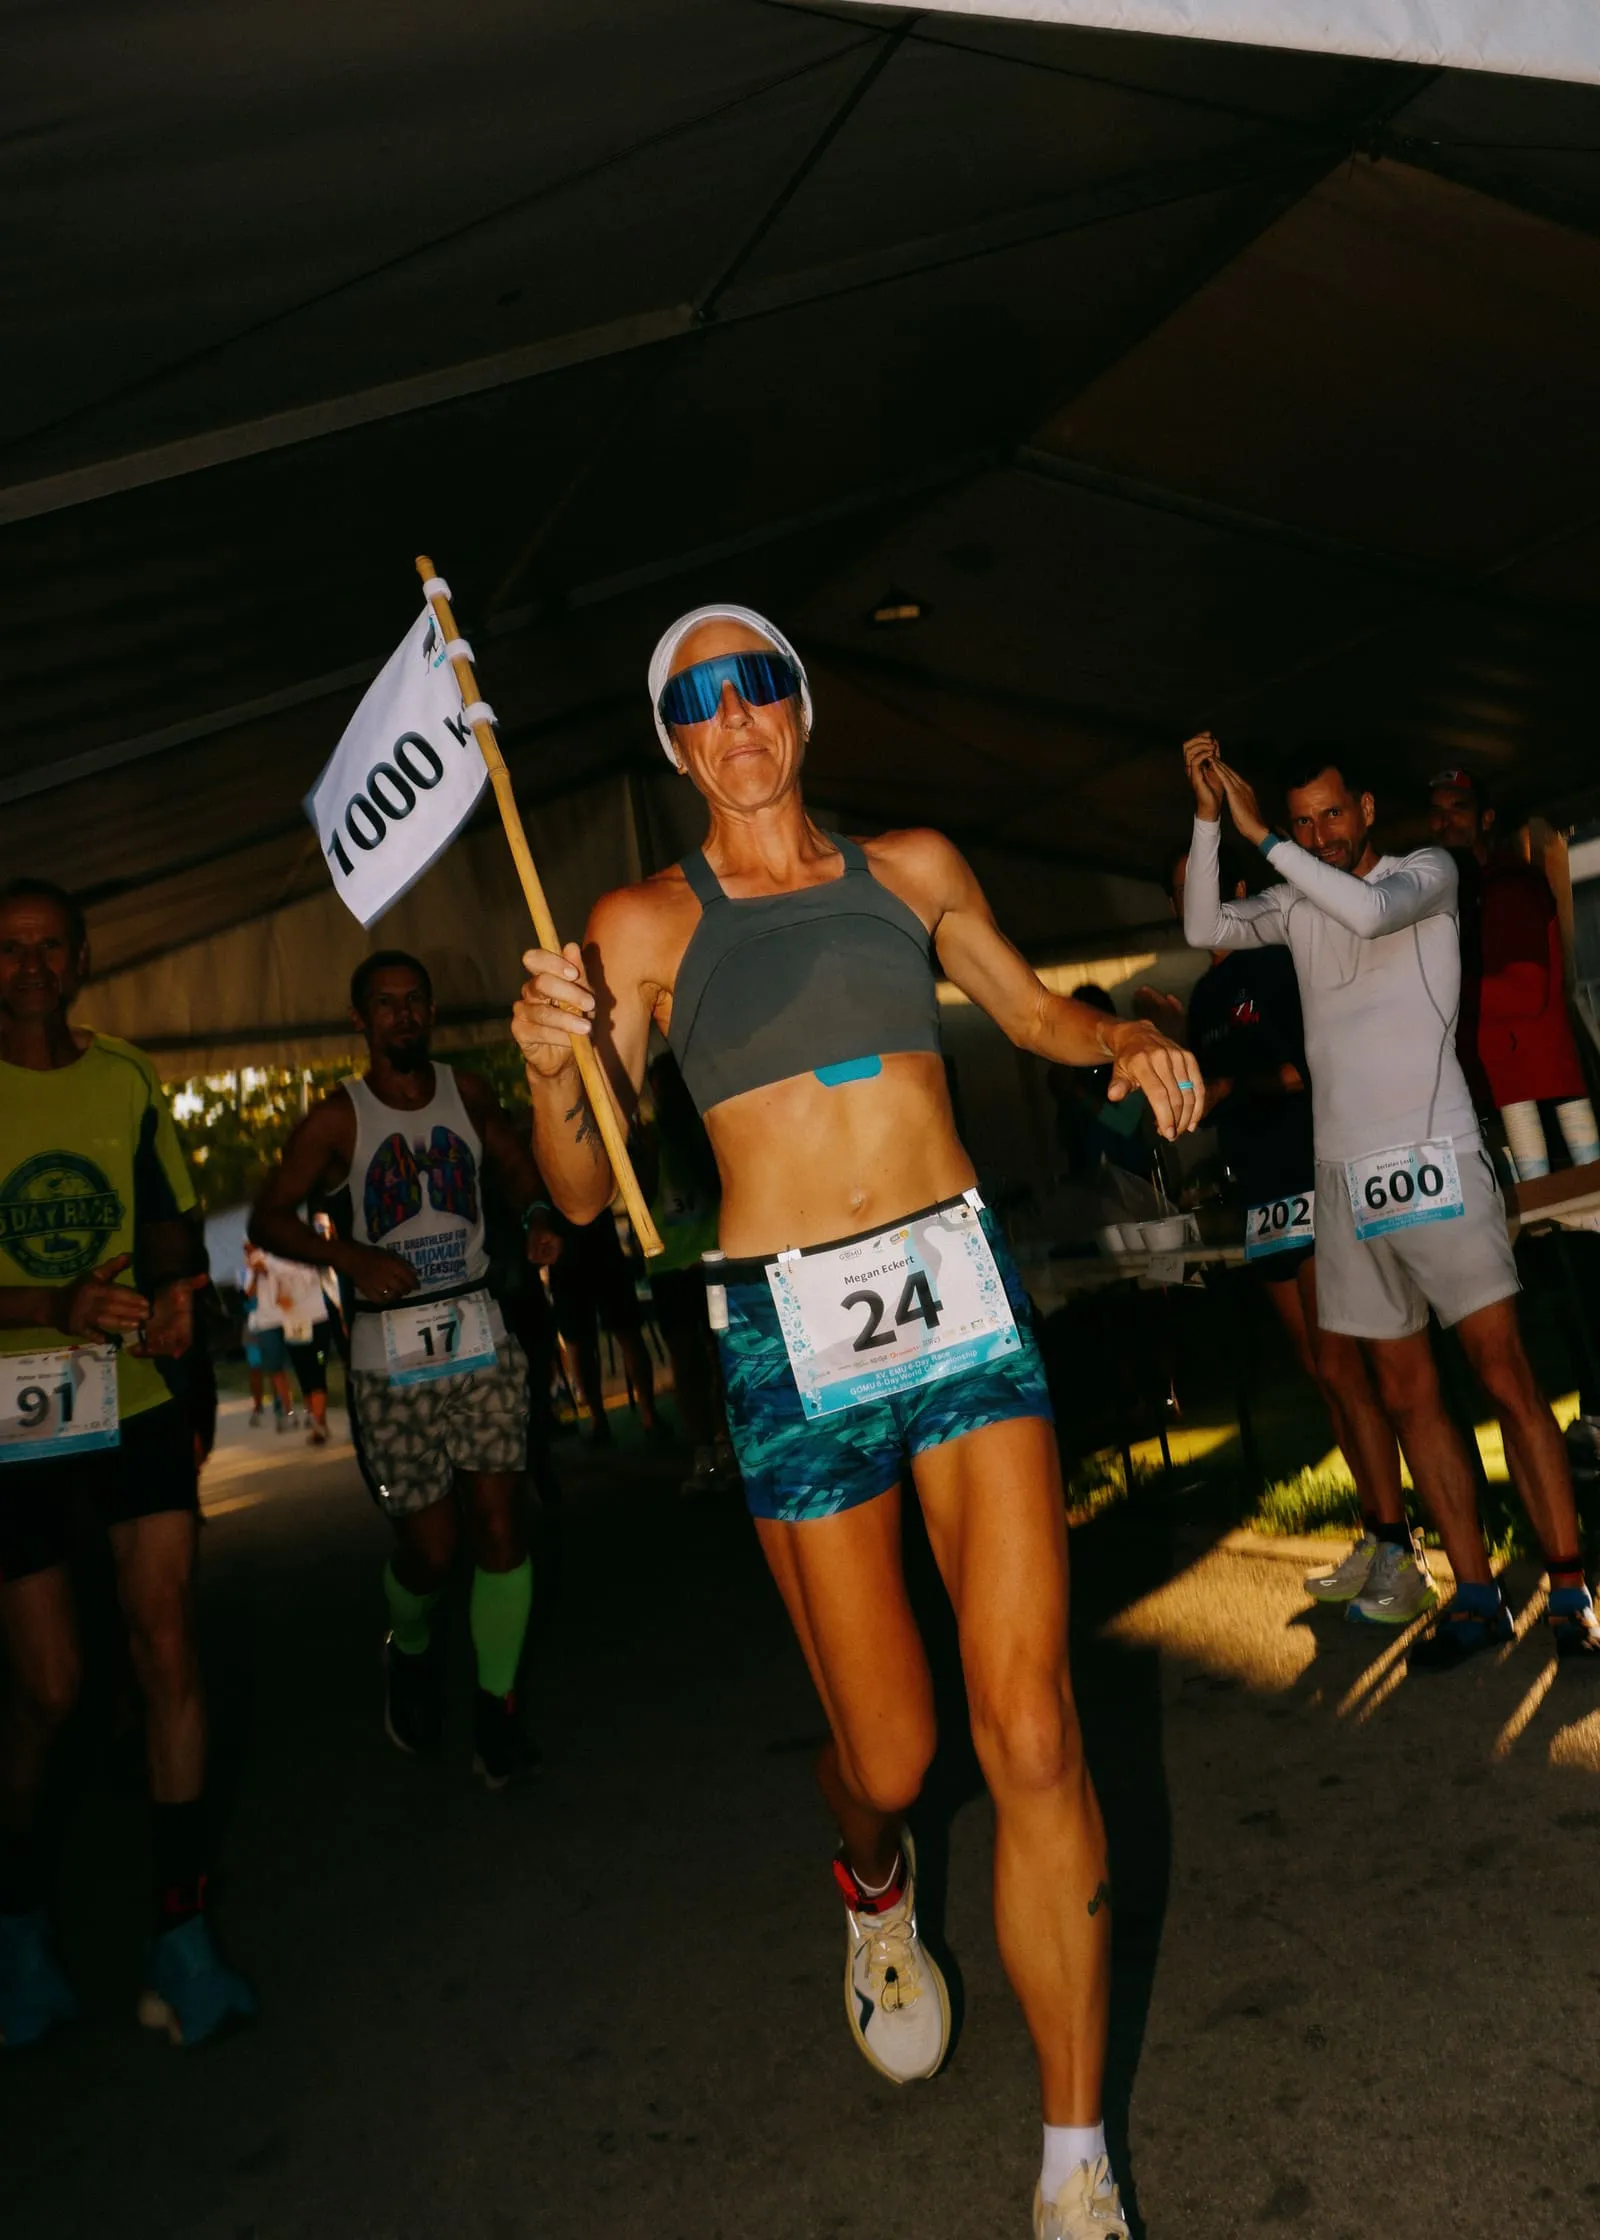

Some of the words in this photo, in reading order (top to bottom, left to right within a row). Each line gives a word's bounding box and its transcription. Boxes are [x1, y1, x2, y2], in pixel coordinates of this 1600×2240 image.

[327, 731, 444, 877] 1000
[1365, 1164, 1444, 1209] 600
[1257, 1197, 1310, 1235] 202
[844, 1269, 880, 1285] Megan
[881, 1255, 915, 1274] Eckert
[840, 1270, 944, 1352] 24
[416, 1320, 457, 1357] 17
[900, 1367, 922, 1381] World
[16, 1382, 73, 1428] 91
